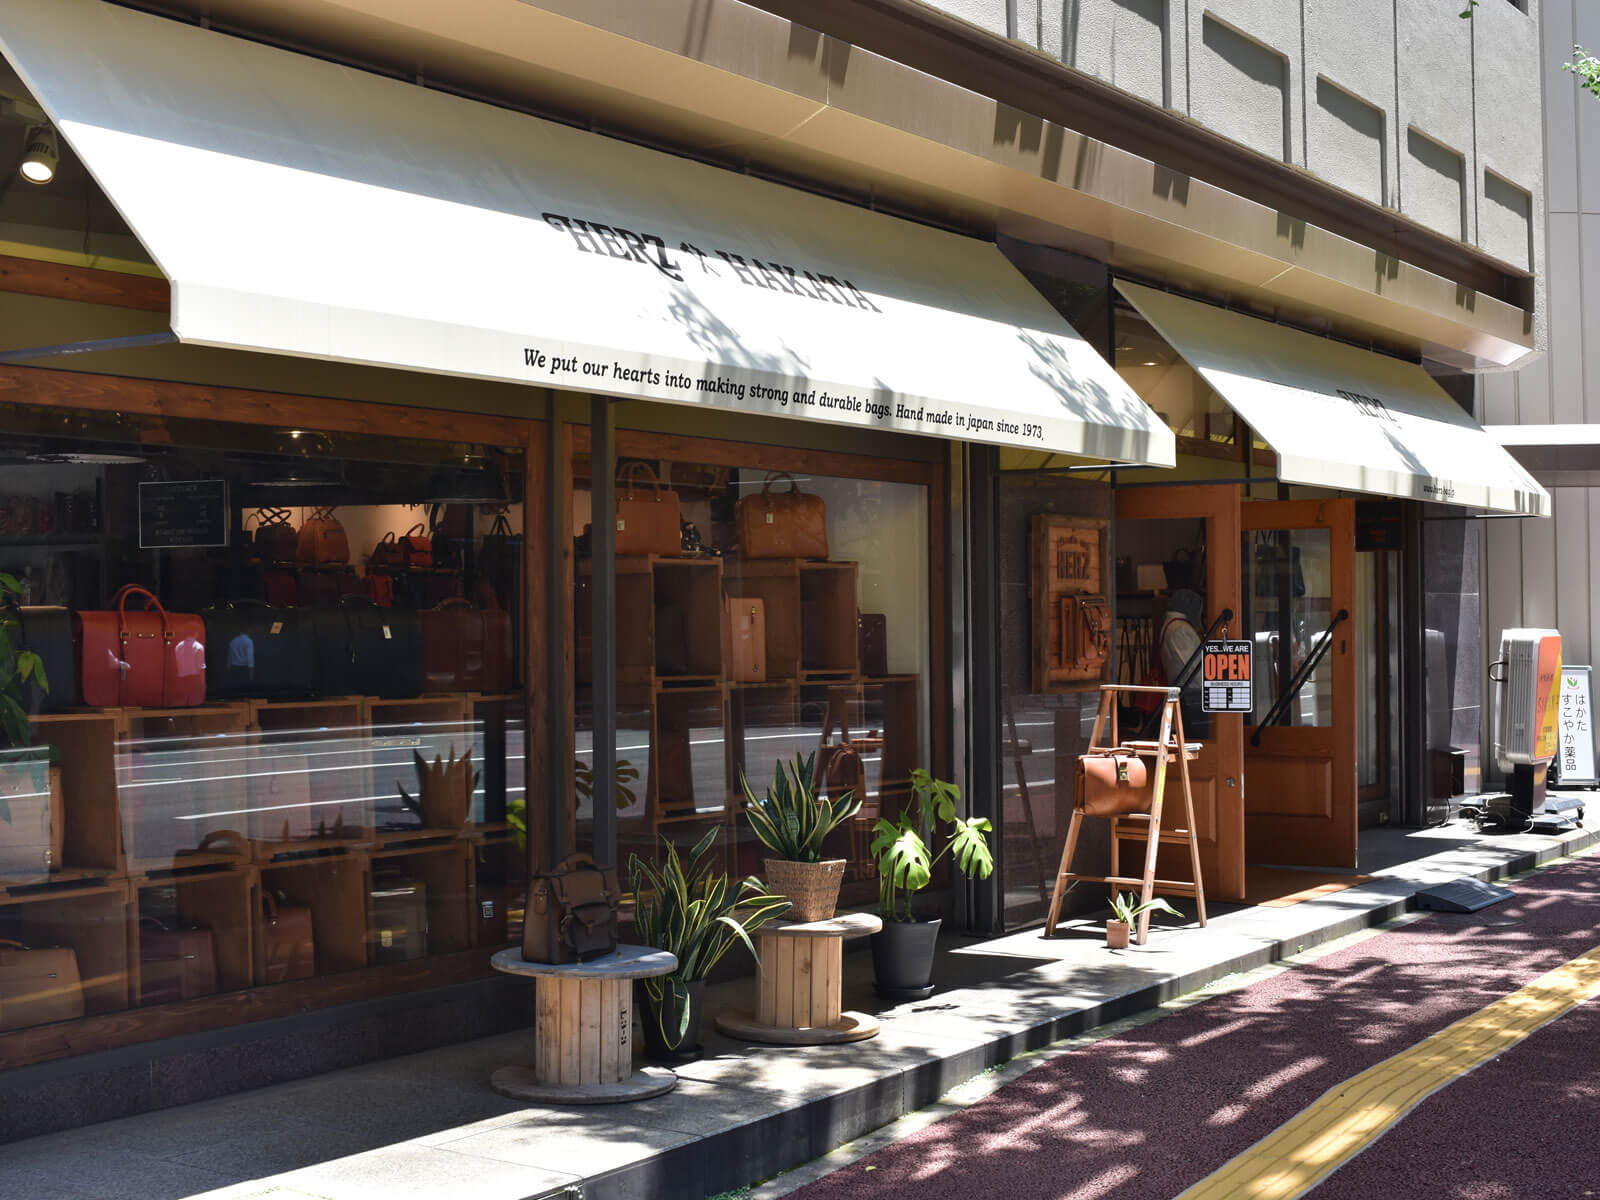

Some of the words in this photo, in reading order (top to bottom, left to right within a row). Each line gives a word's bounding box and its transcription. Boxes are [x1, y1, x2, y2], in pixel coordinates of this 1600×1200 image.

[541, 212, 684, 282] HERZ
[715, 249, 883, 314] HAKATA
[524, 348, 546, 368] We
[550, 355, 578, 375] put
[582, 361, 609, 377] our
[613, 362, 660, 385] hearts
[665, 370, 692, 389] into
[696, 377, 745, 400] making
[749, 384, 789, 406] strong
[792, 390, 816, 405] and
[819, 392, 862, 412] durable
[865, 399, 893, 420] bags.
[896, 404, 924, 421] Hand
[926, 411, 953, 426] made
[956, 414, 965, 427] in
[965, 414, 994, 432] japan
[996, 419, 1019, 435] since
[1204, 653, 1250, 680] OPEN
[1562, 694, 1576, 771] すこやか薬品
[1575, 695, 1587, 732] はかた
